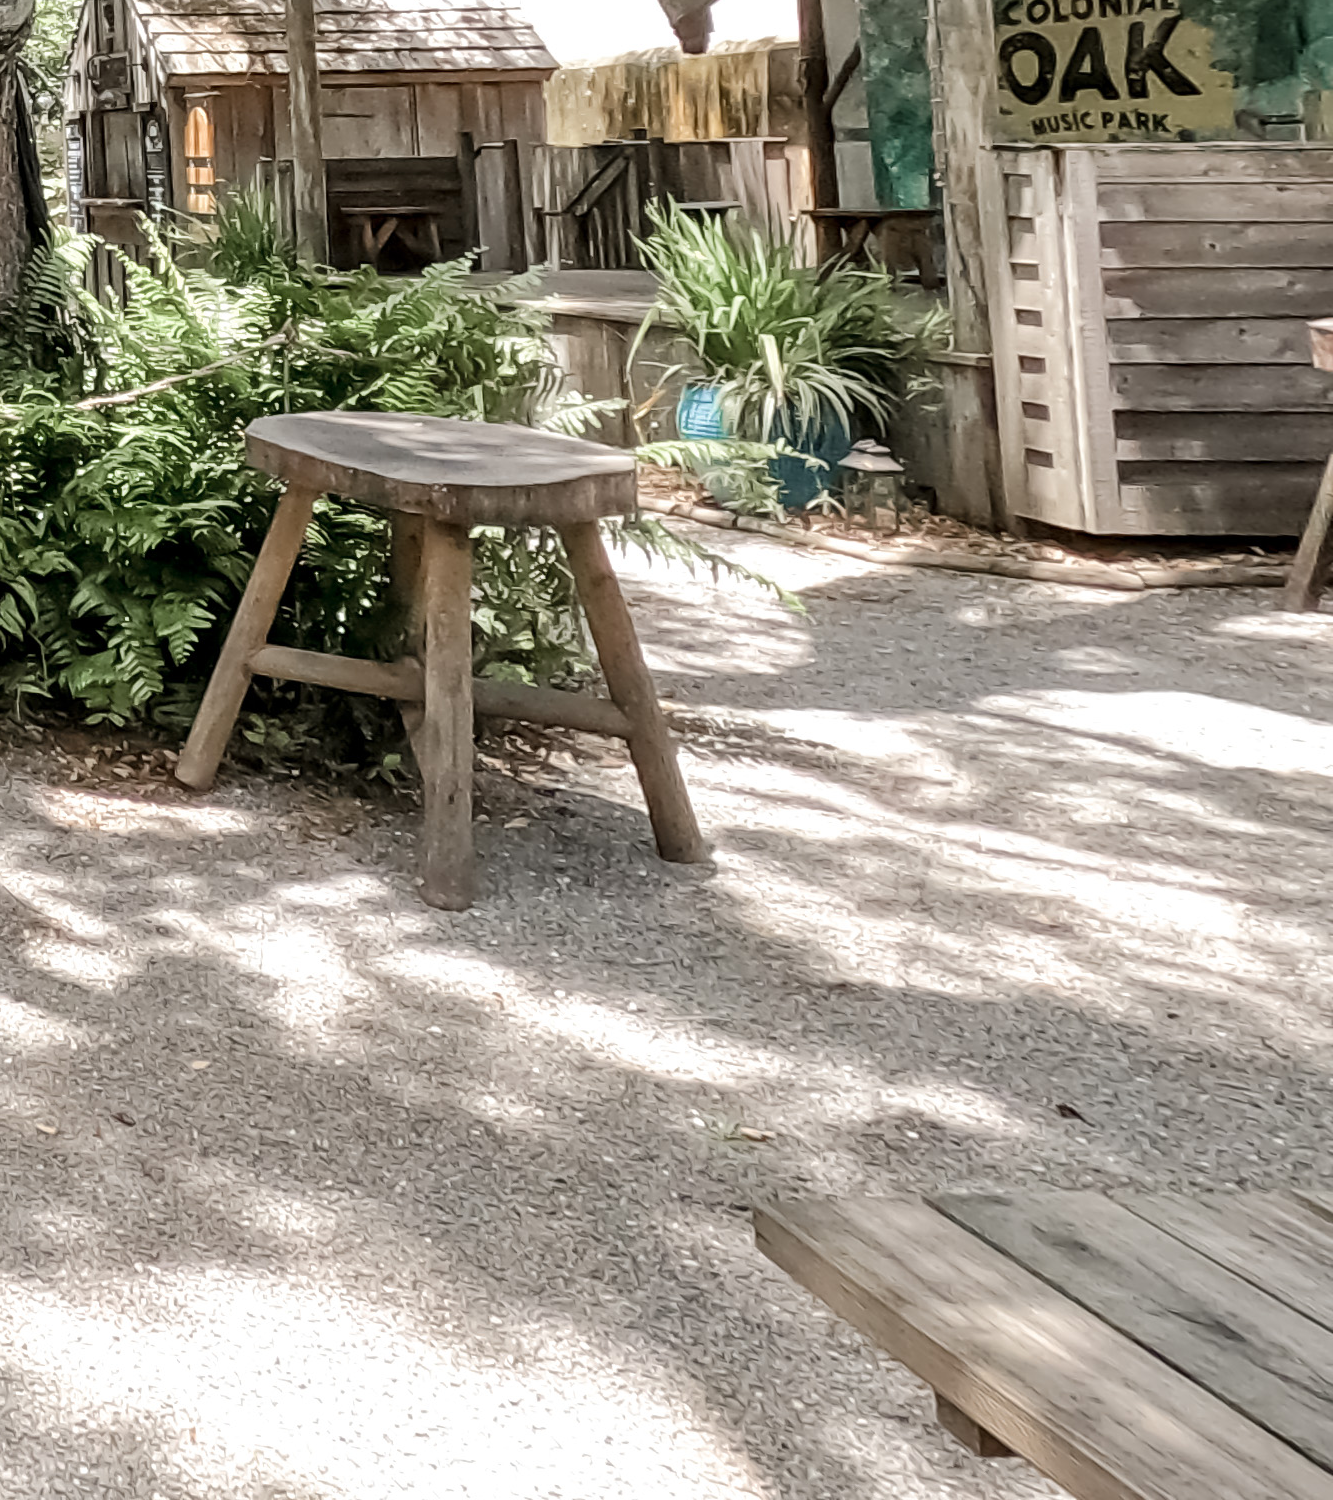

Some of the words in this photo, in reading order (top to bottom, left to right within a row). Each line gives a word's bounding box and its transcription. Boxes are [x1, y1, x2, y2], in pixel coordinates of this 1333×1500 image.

[999, 12, 1203, 105] OAK
[1031, 110, 1096, 135] MUSIC
[1100, 108, 1172, 133] PARK
